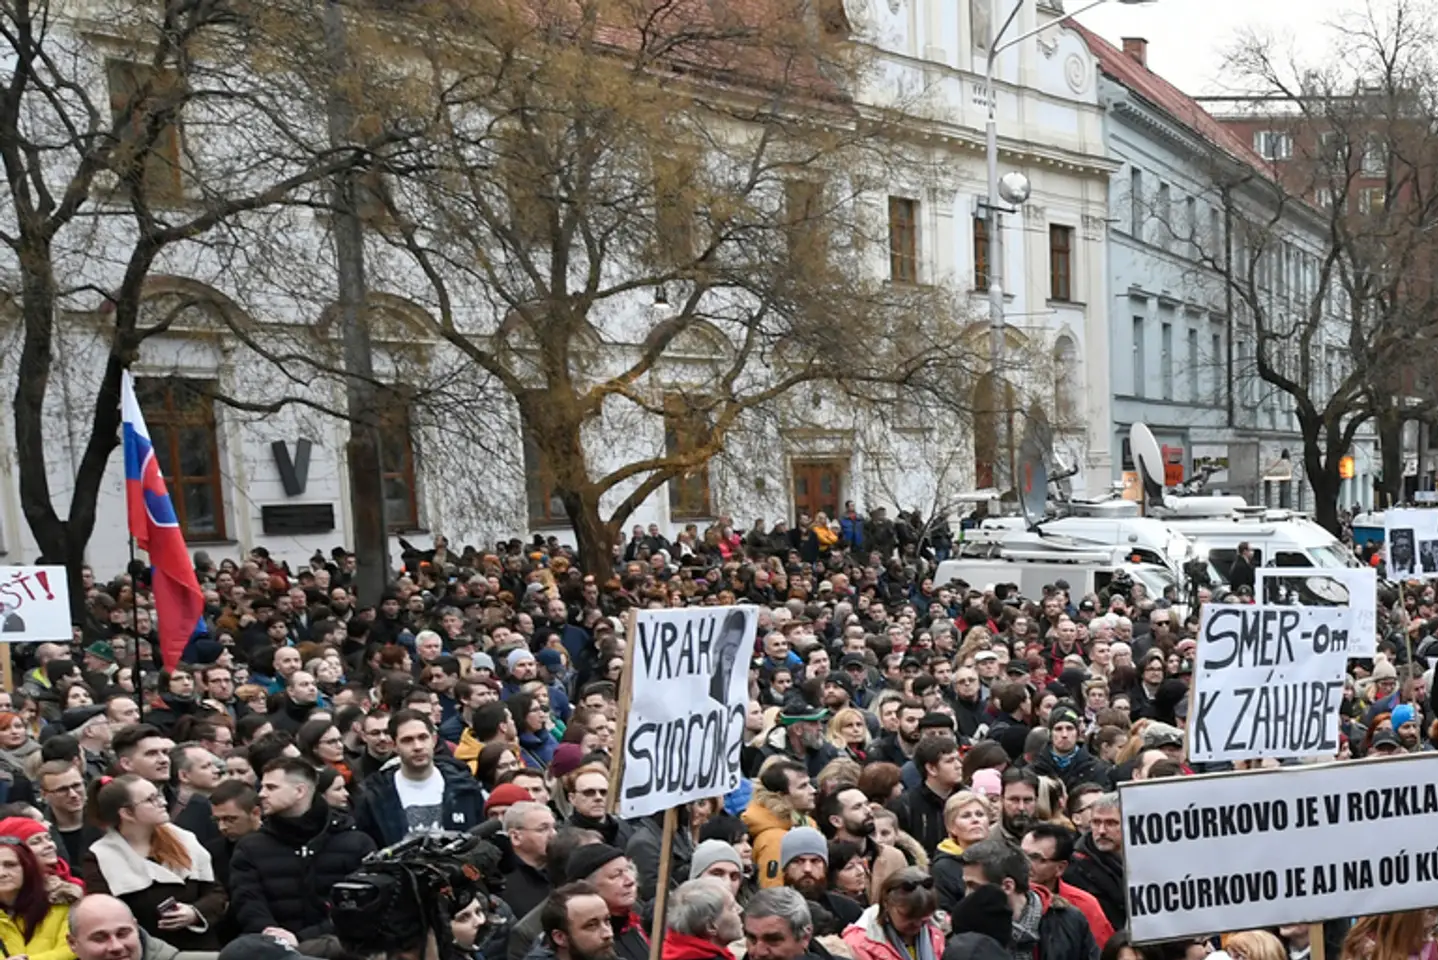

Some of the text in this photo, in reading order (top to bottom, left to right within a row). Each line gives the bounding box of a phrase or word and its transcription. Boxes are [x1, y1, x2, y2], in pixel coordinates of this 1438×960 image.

[637, 617, 715, 680] VRAH
[1195, 669, 1344, 754] K ZÁHUBE
[1128, 799, 1288, 846] KOCÚRKOVO
[1295, 797, 1319, 828] JE
[1324, 795, 1341, 825] V
[1130, 870, 1278, 917] KOCÚRKOVO
[1284, 867, 1307, 899] JE
[1312, 863, 1337, 896] AJ
[1343, 859, 1374, 891] NA
[1379, 852, 1409, 887] OÚ
